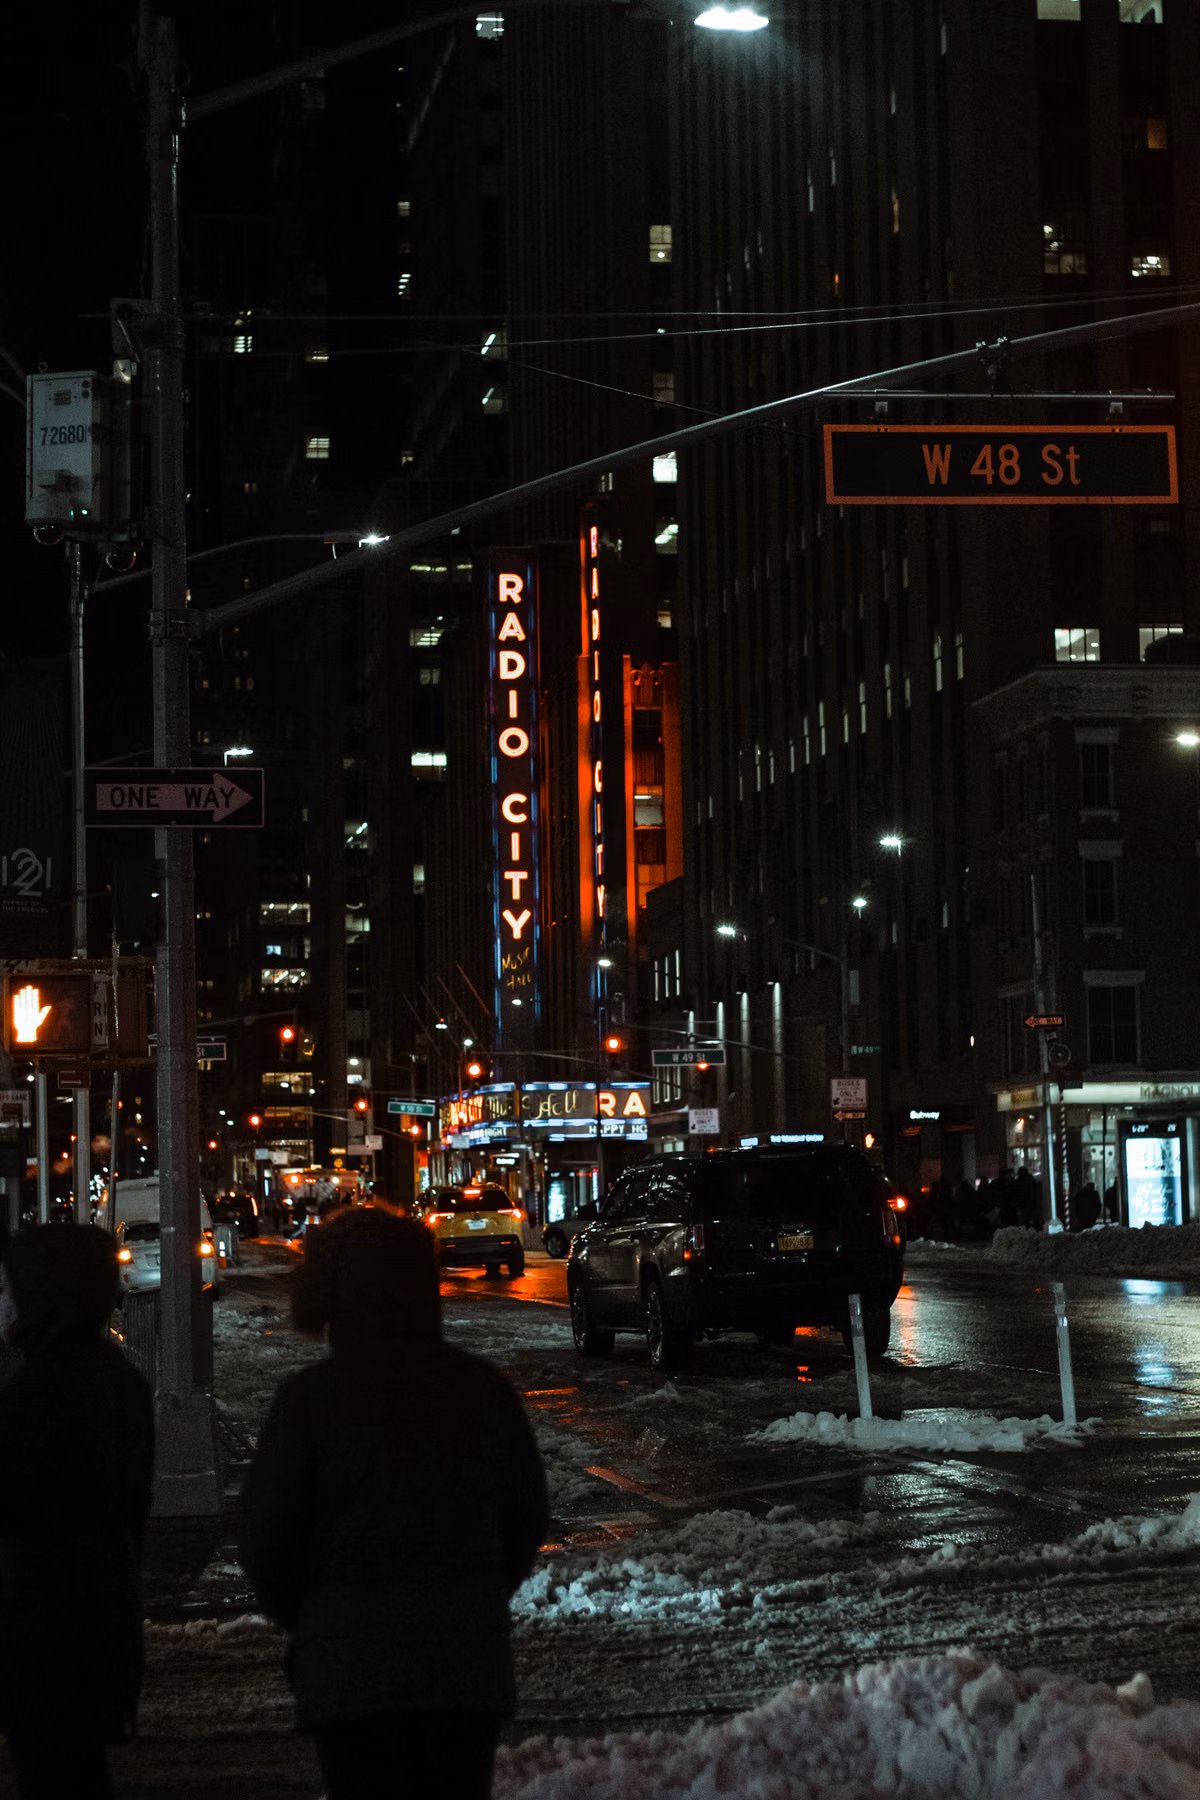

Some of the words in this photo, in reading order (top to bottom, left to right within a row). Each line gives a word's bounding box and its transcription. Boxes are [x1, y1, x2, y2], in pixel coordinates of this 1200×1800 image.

[922, 443, 952, 485] W
[970, 443, 1021, 486] 48
[1041, 443, 1081, 486] St
[498, 573, 530, 758] RADIO
[110, 786, 160, 808] ONE
[184, 786, 236, 809] WAY
[502, 792, 532, 940] CITY
[672, 1052, 680, 1063] W
[682, 1052, 695, 1063] 49
[909, 1109, 941, 1121] Subway
[588, 1124, 625, 1134] HPPY
